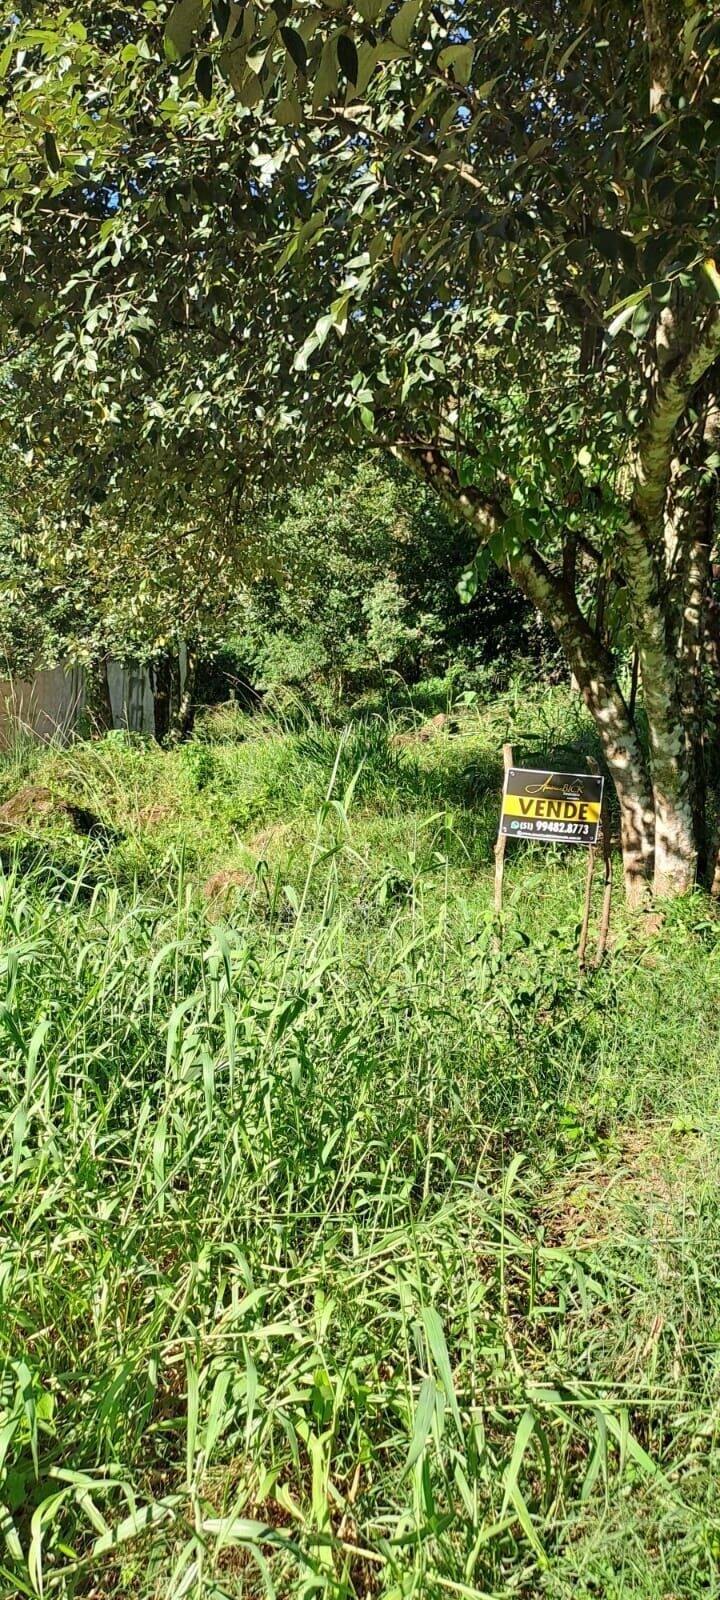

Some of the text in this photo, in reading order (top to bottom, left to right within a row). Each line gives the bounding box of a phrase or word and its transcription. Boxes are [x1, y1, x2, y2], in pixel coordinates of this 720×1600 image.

[519, 798, 589, 820] VENDE
[520, 820, 589, 834] (51) 99482.8773
